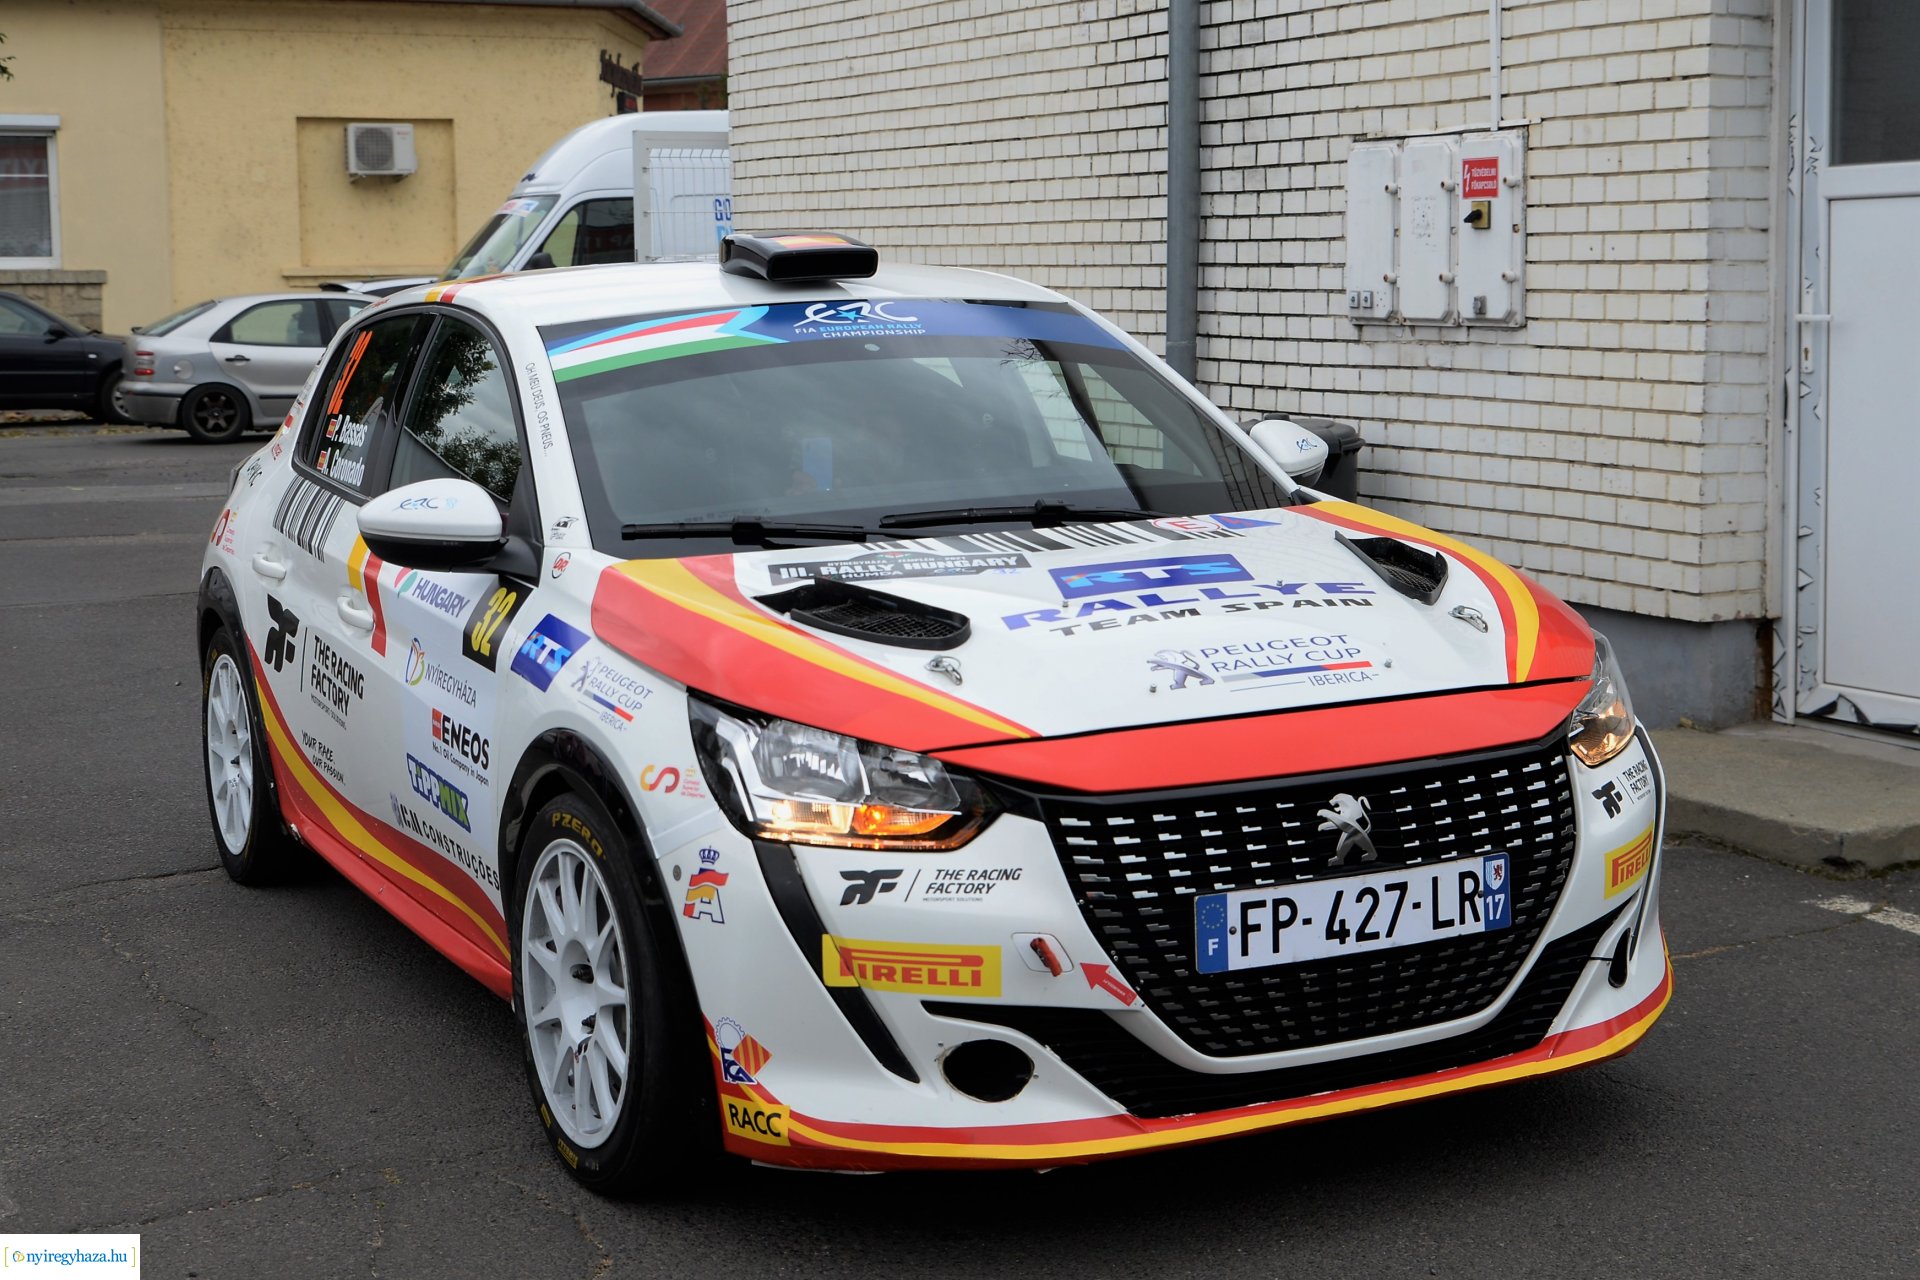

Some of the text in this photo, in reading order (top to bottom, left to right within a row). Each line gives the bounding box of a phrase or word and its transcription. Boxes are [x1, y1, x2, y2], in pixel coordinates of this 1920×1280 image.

[820, 324, 884, 333] EUROPEAN
[822, 329, 927, 338] CHAMPIONSHIP
[338, 415, 368, 447] Bassas
[779, 556, 1019, 579] III. RALLY HUNGARY
[1061, 561, 1243, 590] RTS
[412, 577, 470, 618] HUNGARY
[1000, 581, 1377, 631] RALLYE
[471, 587, 517, 657] 32
[1049, 597, 1374, 637] TEAM SPAIN
[520, 630, 572, 673] RTS
[1199, 634, 1348, 659] PEUGEOT
[1211, 648, 1362, 673] RALLY CUP
[314, 635, 365, 700] THE RACING
[599, 665, 653, 699] PEUGEOT
[310, 664, 350, 717] FACTORY
[424, 663, 478, 708] NYÍREGYHÁZA
[589, 677, 643, 711] RALLY CUP
[442, 714, 489, 771] ENEOS
[450, 753, 470, 776] Company
[925, 882, 996, 894] FACTORY
[934, 868, 1023, 881] THE RACING
[1240, 870, 1481, 957] FP-427-LR
[1485, 893, 1506, 921] 17
[1208, 938, 1219, 956] F
[839, 945, 985, 988] PIRELLI
[728, 1103, 782, 1138] RACC
